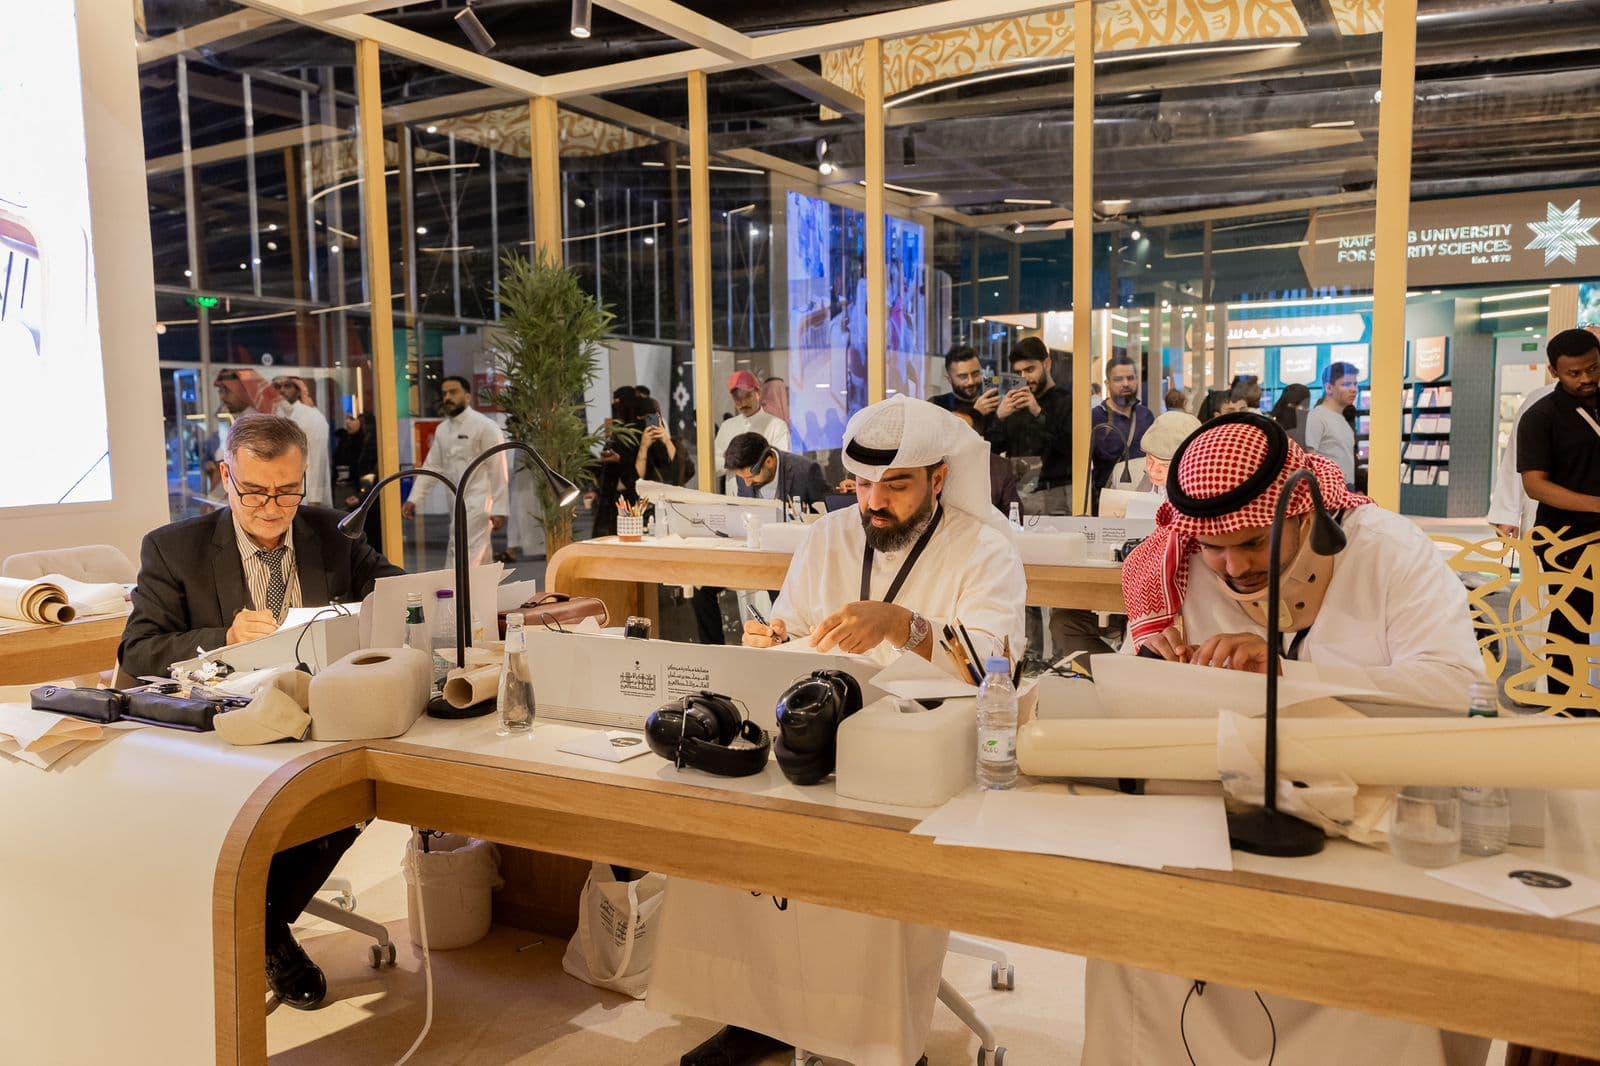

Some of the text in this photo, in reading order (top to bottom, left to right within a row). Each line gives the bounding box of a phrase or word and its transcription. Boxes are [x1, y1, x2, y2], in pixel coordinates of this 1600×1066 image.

[1338, 236, 1373, 249] NAIF
[1420, 223, 1513, 242] UNIVERSITY
[1337, 239, 1513, 264] FOR SRITY SCIENCES
